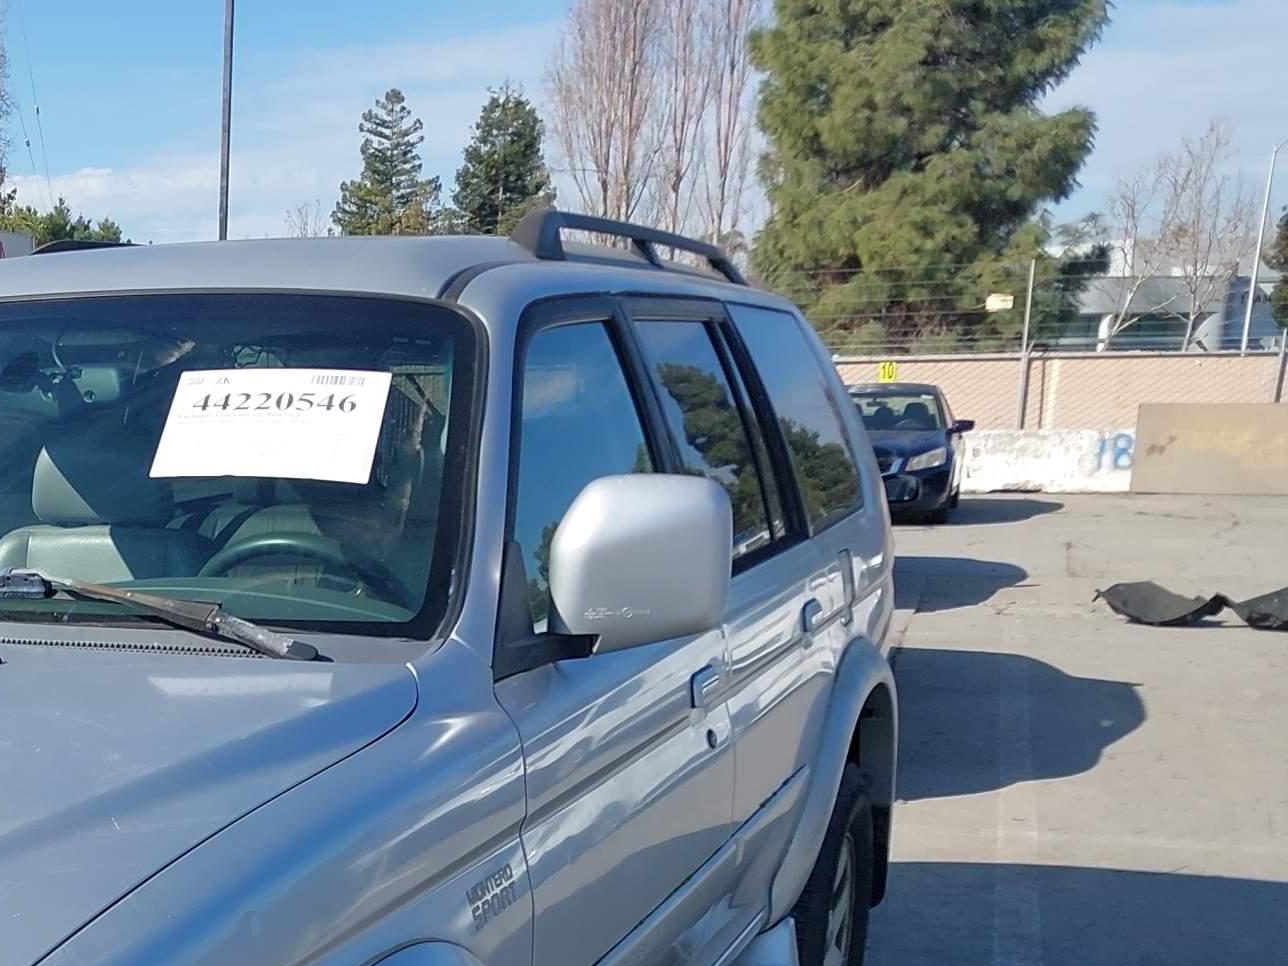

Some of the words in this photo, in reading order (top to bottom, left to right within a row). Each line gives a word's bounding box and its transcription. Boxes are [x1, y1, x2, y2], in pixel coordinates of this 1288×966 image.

[192, 391, 358, 414] 44220546
[1095, 433, 1134, 472] 18
[471, 881, 517, 932] SPORT
